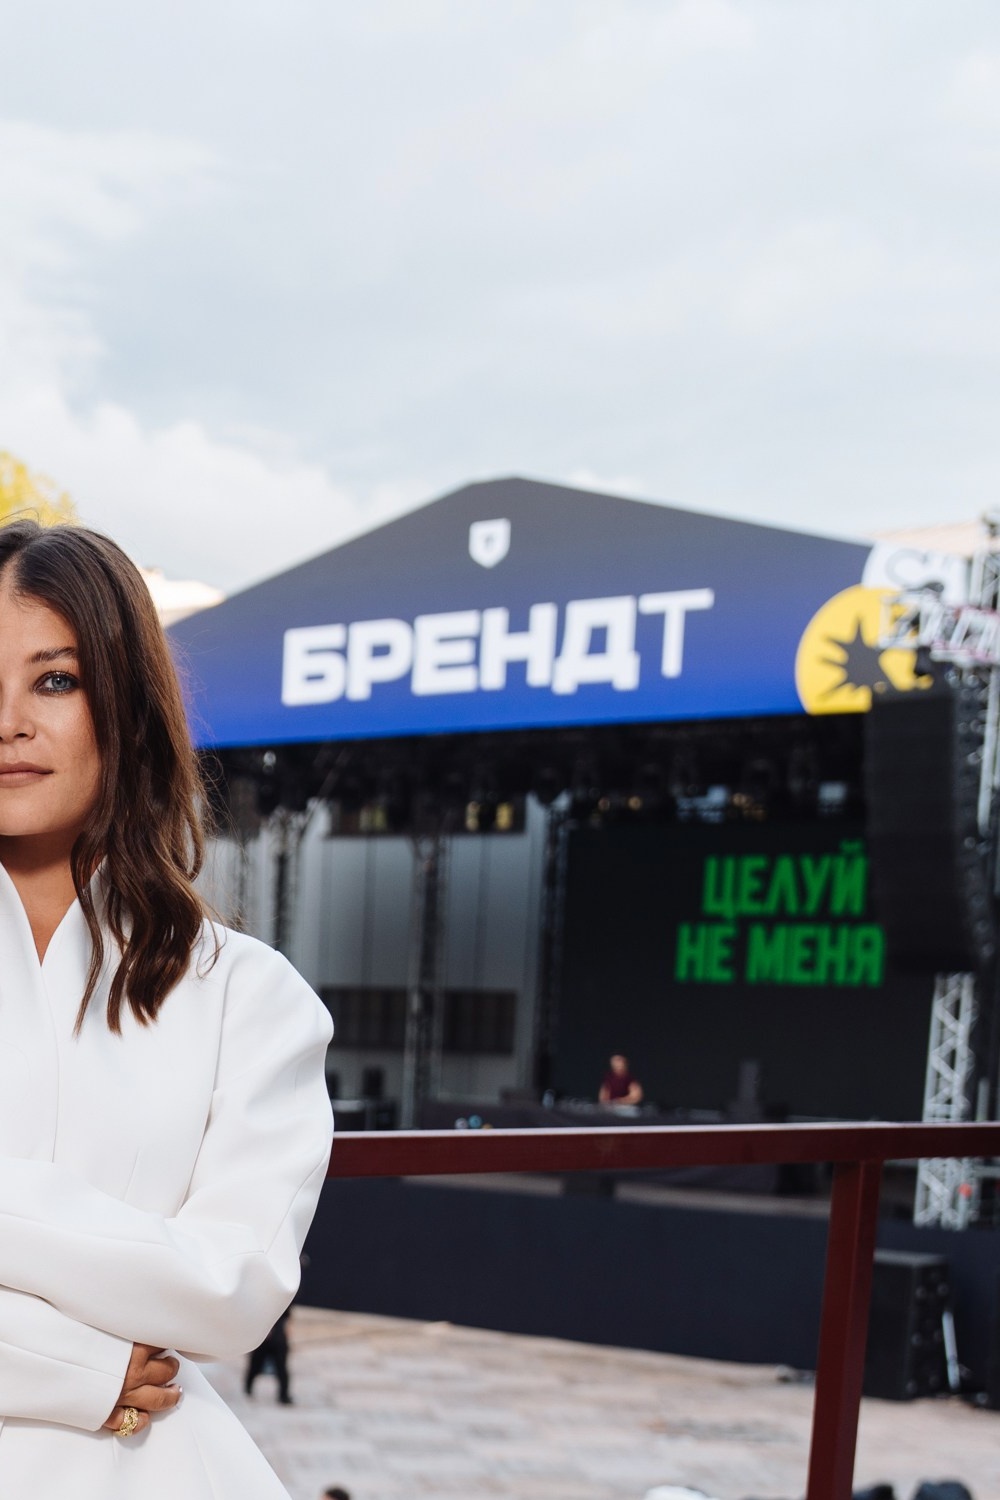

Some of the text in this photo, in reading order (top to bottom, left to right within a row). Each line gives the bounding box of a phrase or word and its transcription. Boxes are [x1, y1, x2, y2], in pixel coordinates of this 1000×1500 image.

[281, 588, 715, 707] БРЕНДТ
[702, 839, 868, 922] ЦЕЛУЙ
[675, 922, 886, 988] НЕ МЕНЯ
